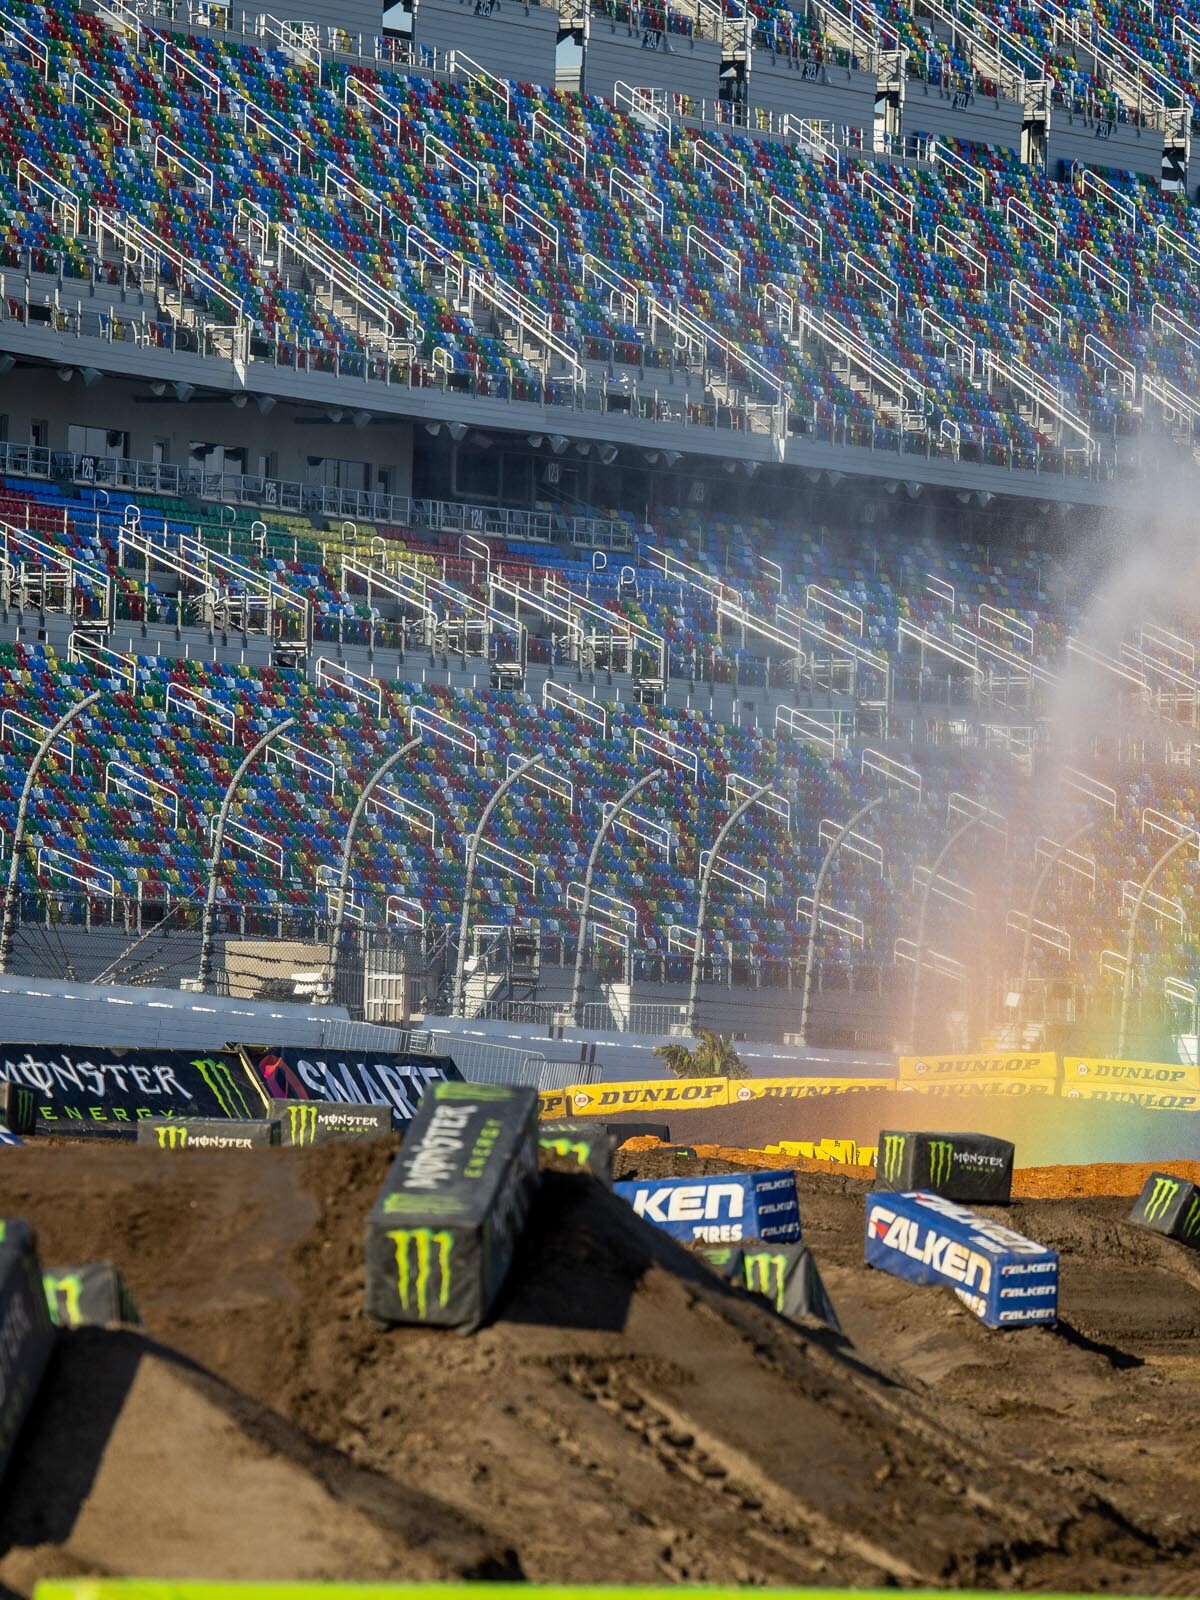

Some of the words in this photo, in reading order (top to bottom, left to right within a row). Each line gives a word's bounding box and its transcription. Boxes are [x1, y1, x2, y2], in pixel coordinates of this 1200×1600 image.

[645, 29, 657, 49] 324
[805, 62, 817, 81] 323
[955, 92, 966, 111] 322
[82, 457, 94, 479] 126
[548, 463, 559, 483] 123
[265, 482, 277, 503] 125
[471, 509, 483, 529] 124
[935, 1059, 1041, 1073] DUNLOP
[1094, 1065, 1186, 1082] DUNLOP
[598, 1084, 724, 1106] DUNLOP
[1089, 1090, 1197, 1108] DUNLOP
[318, 1114, 379, 1127] MONSTER
[187, 1135, 253, 1149] MONSTER
[953, 1152, 1004, 1168] MONSTER
[633, 1183, 744, 1222] KEN
[693, 1224, 743, 1243] TIRES
[866, 1205, 993, 1295] FALKEN
[1001, 1263, 1056, 1276] FALKEN
[1001, 1286, 1056, 1297] FALKEN
[1000, 1309, 1055, 1320] FALKEN
